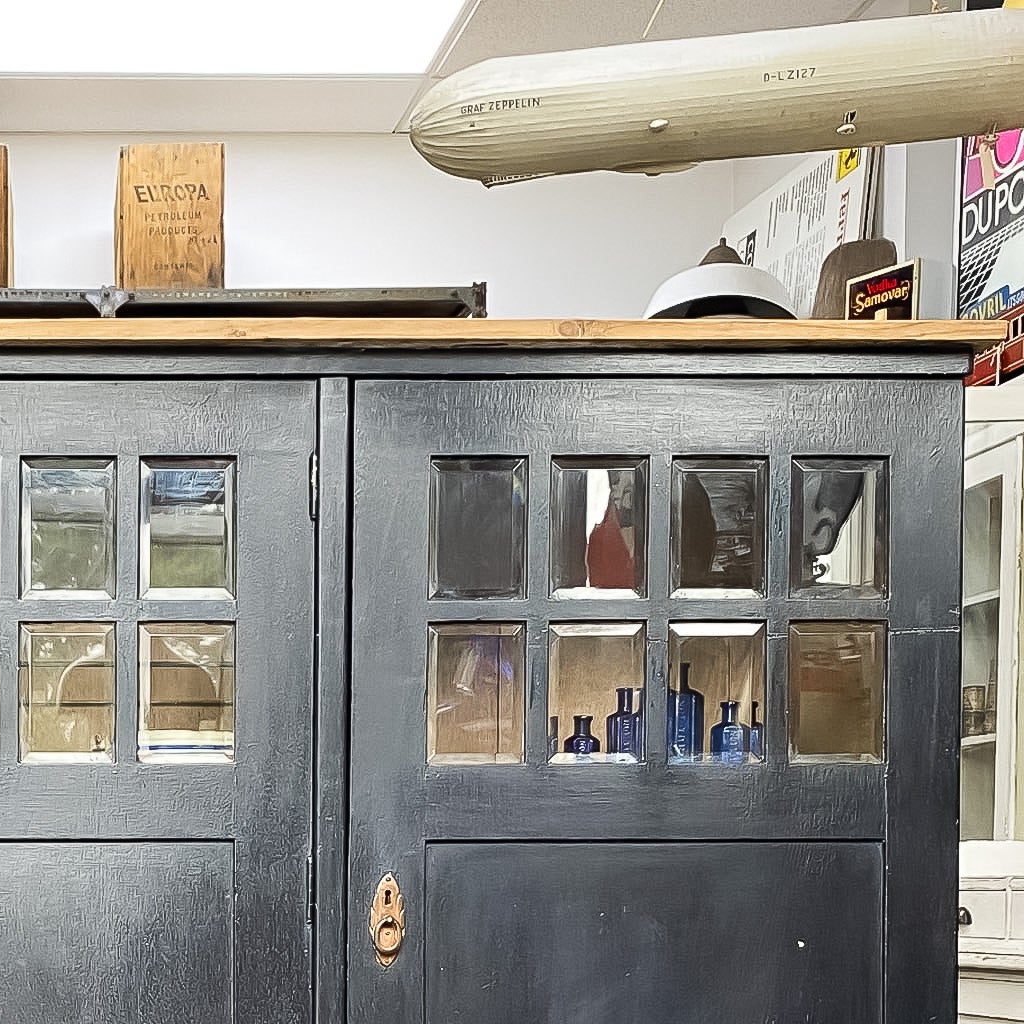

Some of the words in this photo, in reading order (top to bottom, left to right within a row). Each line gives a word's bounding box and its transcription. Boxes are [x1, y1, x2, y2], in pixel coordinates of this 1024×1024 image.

[460, 102, 488, 115] GRAF
[488, 97, 541, 111] ZEPPELIN
[134, 183, 210, 203] EUROPA
[853, 285, 910, 314] Samovar
